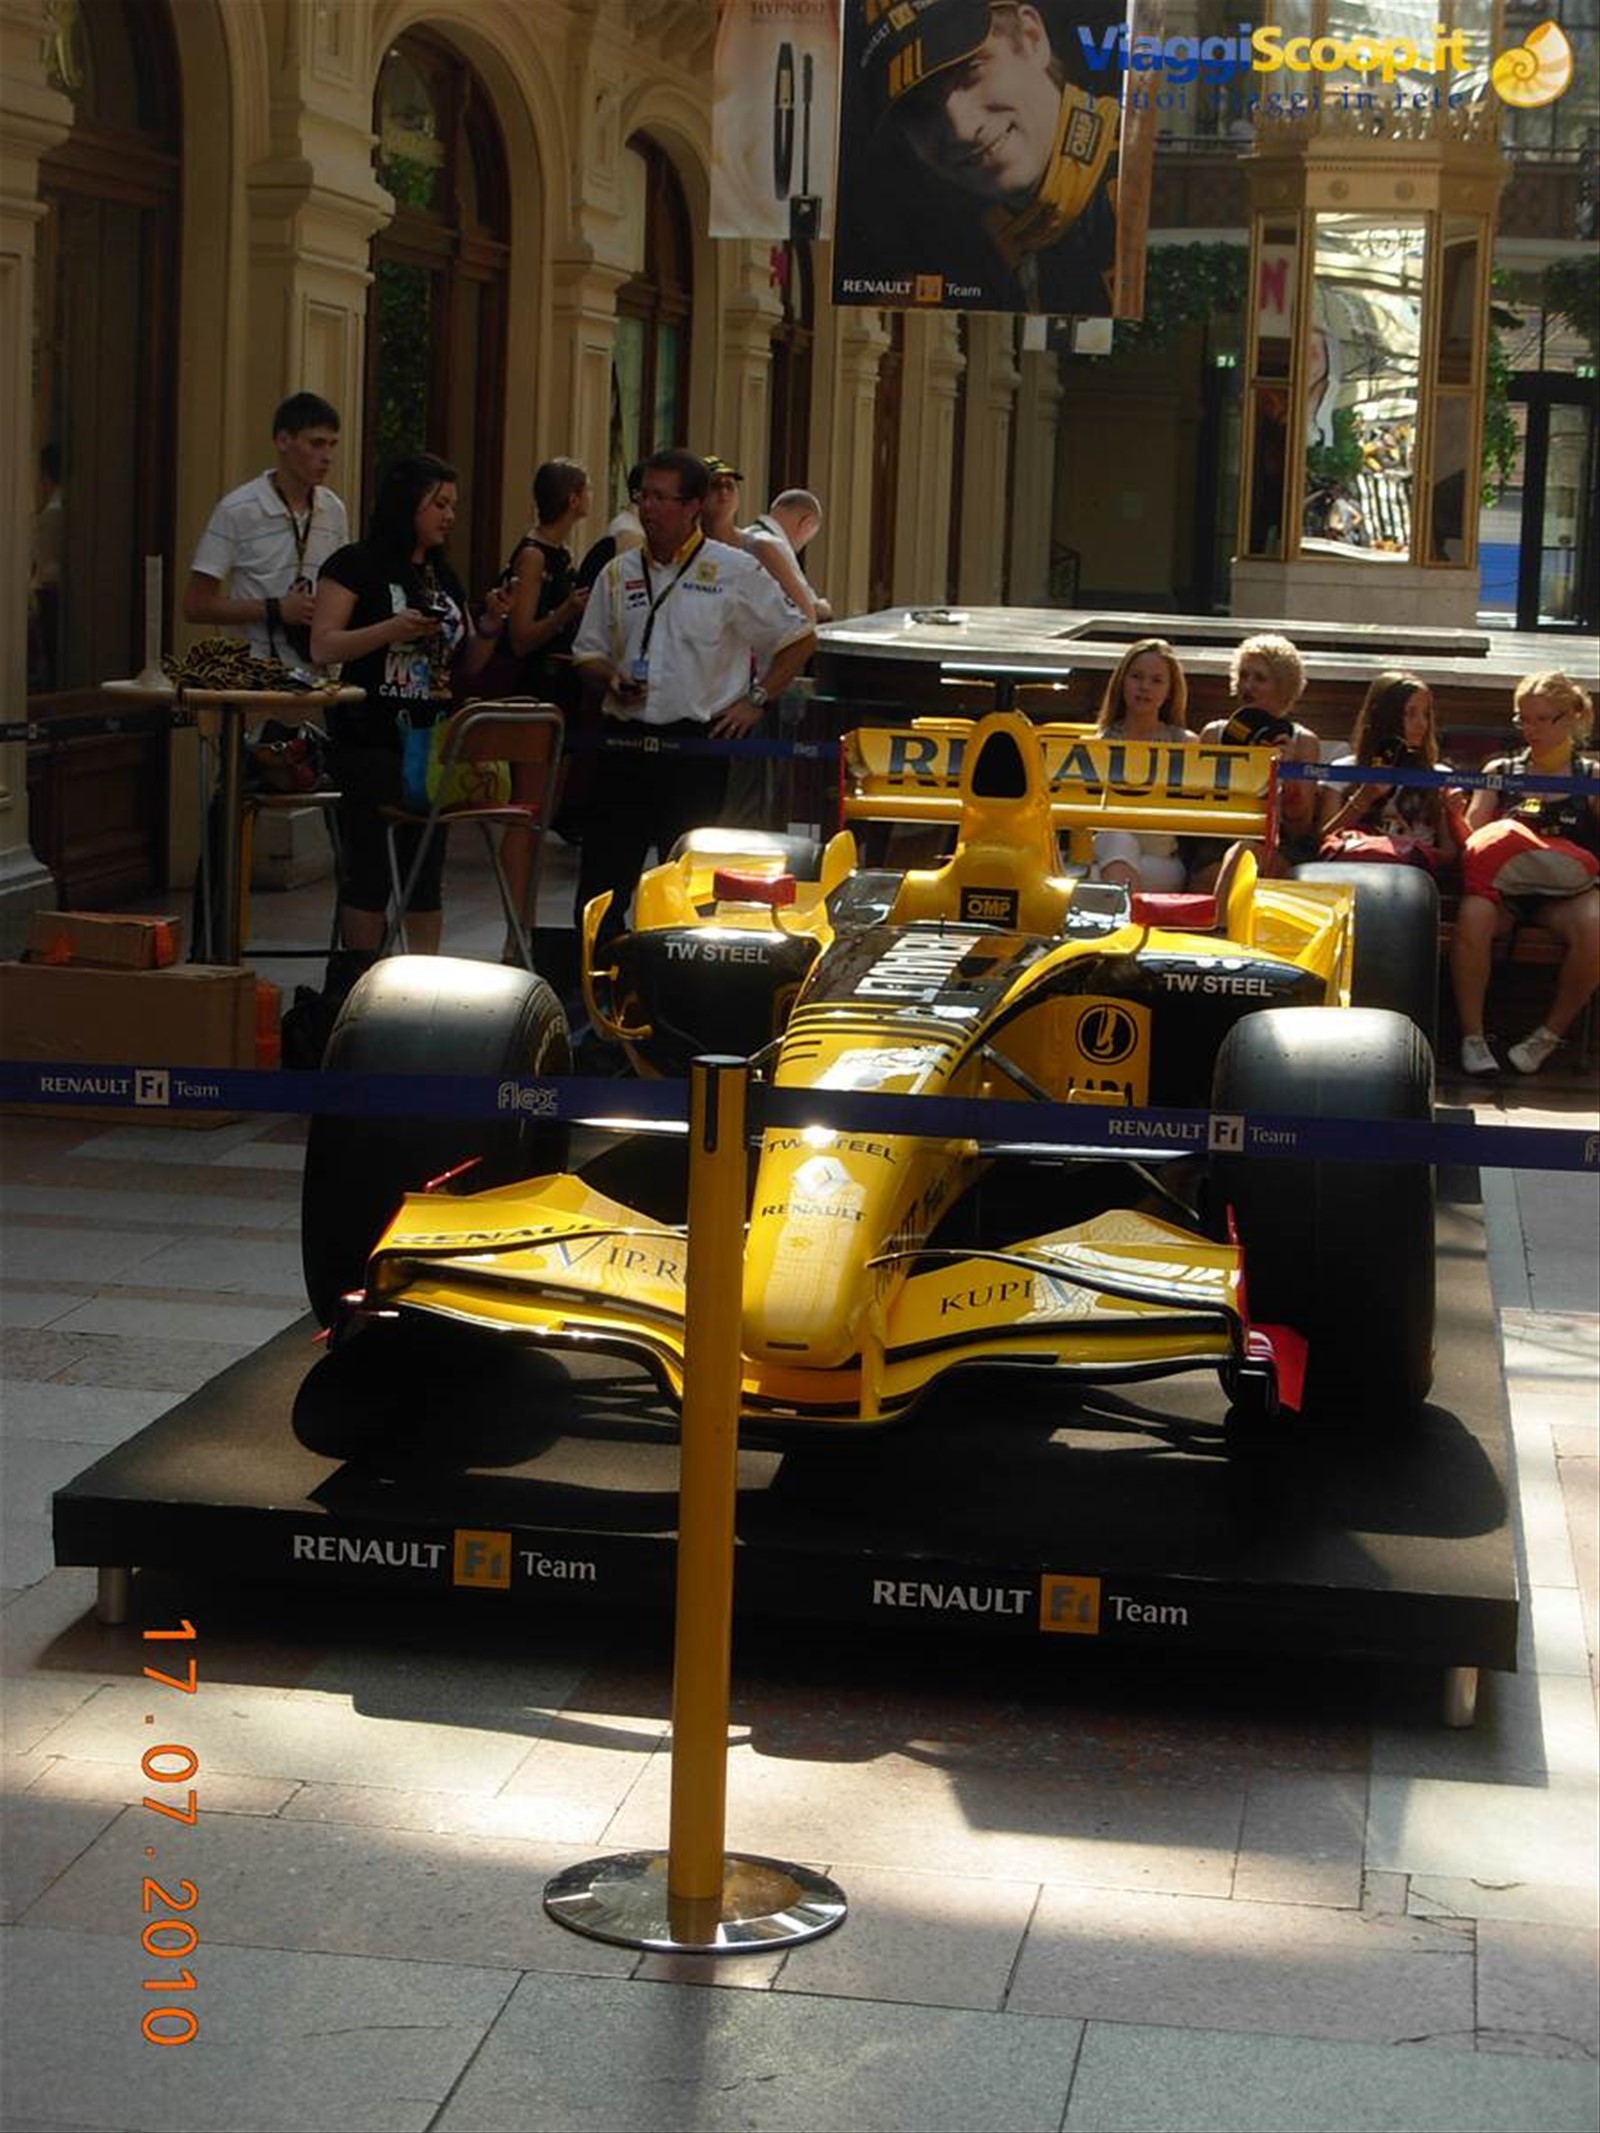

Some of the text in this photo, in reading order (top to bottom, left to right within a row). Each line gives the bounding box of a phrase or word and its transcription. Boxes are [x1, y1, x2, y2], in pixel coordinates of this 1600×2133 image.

[843, 279, 912, 294] RENAULT
[947, 283, 983, 297] Team
[887, 735, 1249, 801] RAULT
[967, 899, 1011, 917] OMP
[664, 942, 769, 965] TW STEEL
[1163, 972, 1274, 997] TW STEEL
[40, 1076, 130, 1095] RENAULT
[174, 1079, 220, 1099] Team
[1108, 1118, 1204, 1139] RENAULT
[1250, 1126, 1297, 1146] Team
[836, 1139, 897, 1165] TEEL
[761, 1203, 867, 1223] RENAULT
[555, 1237, 686, 1284] VIP.R
[293, 1534, 446, 1569] RENAULT
[520, 1550, 597, 1581] Team
[872, 1579, 1031, 1614] RENAULT
[1108, 1596, 1188, 1626] Team
